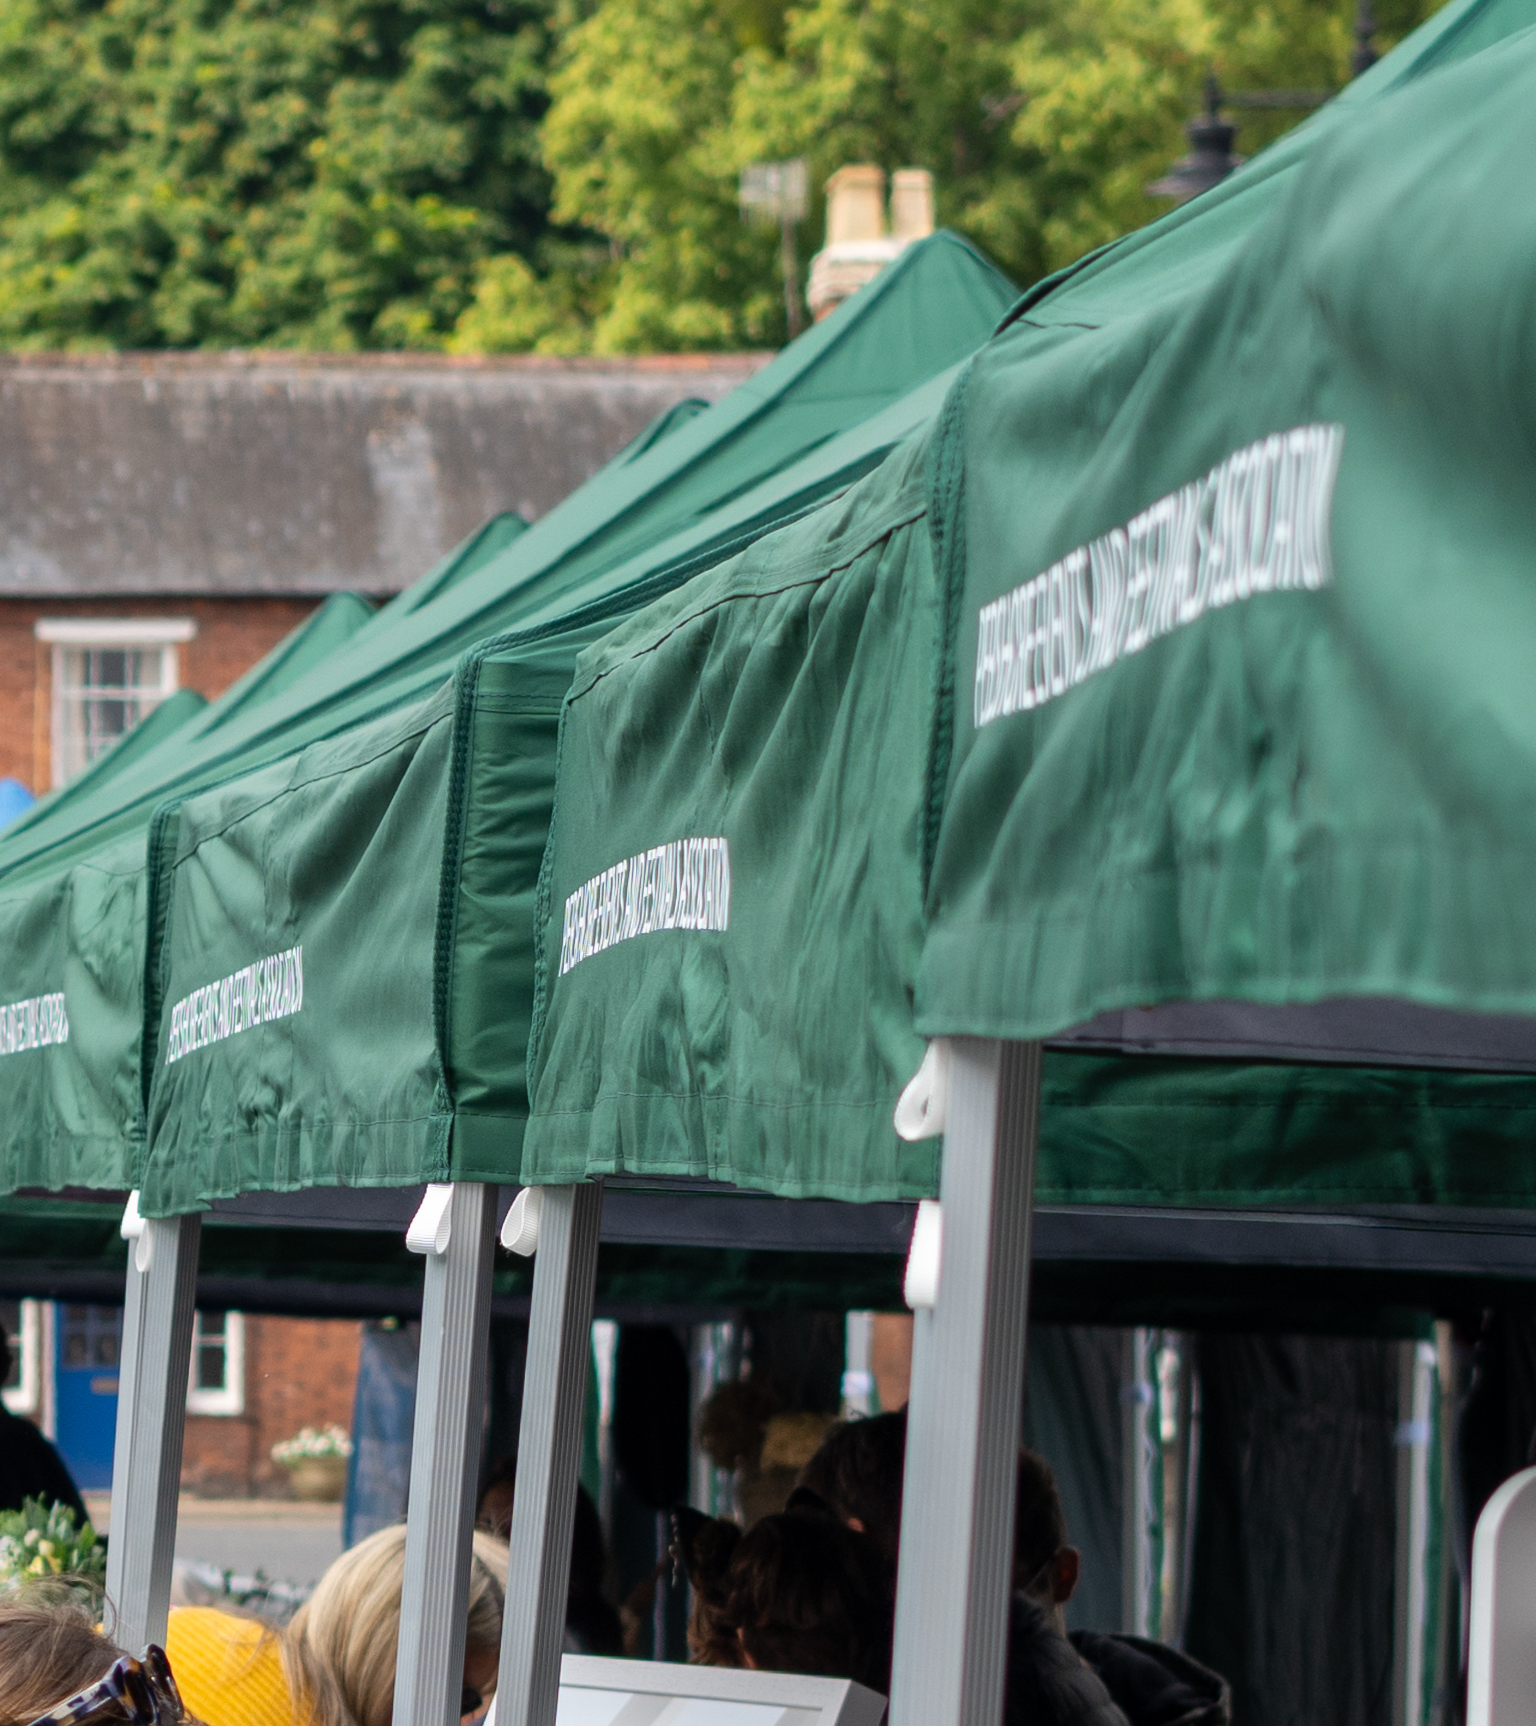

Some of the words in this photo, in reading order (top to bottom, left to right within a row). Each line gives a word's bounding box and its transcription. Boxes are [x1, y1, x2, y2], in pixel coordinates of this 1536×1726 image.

[974, 579, 1035, 729] PERSHORE
[1035, 545, 1092, 705] EVENTS
[1086, 527, 1129, 677] AND
[1117, 470, 1213, 656] FESTIVALS
[1208, 422, 1345, 607] ASSOCIATION
